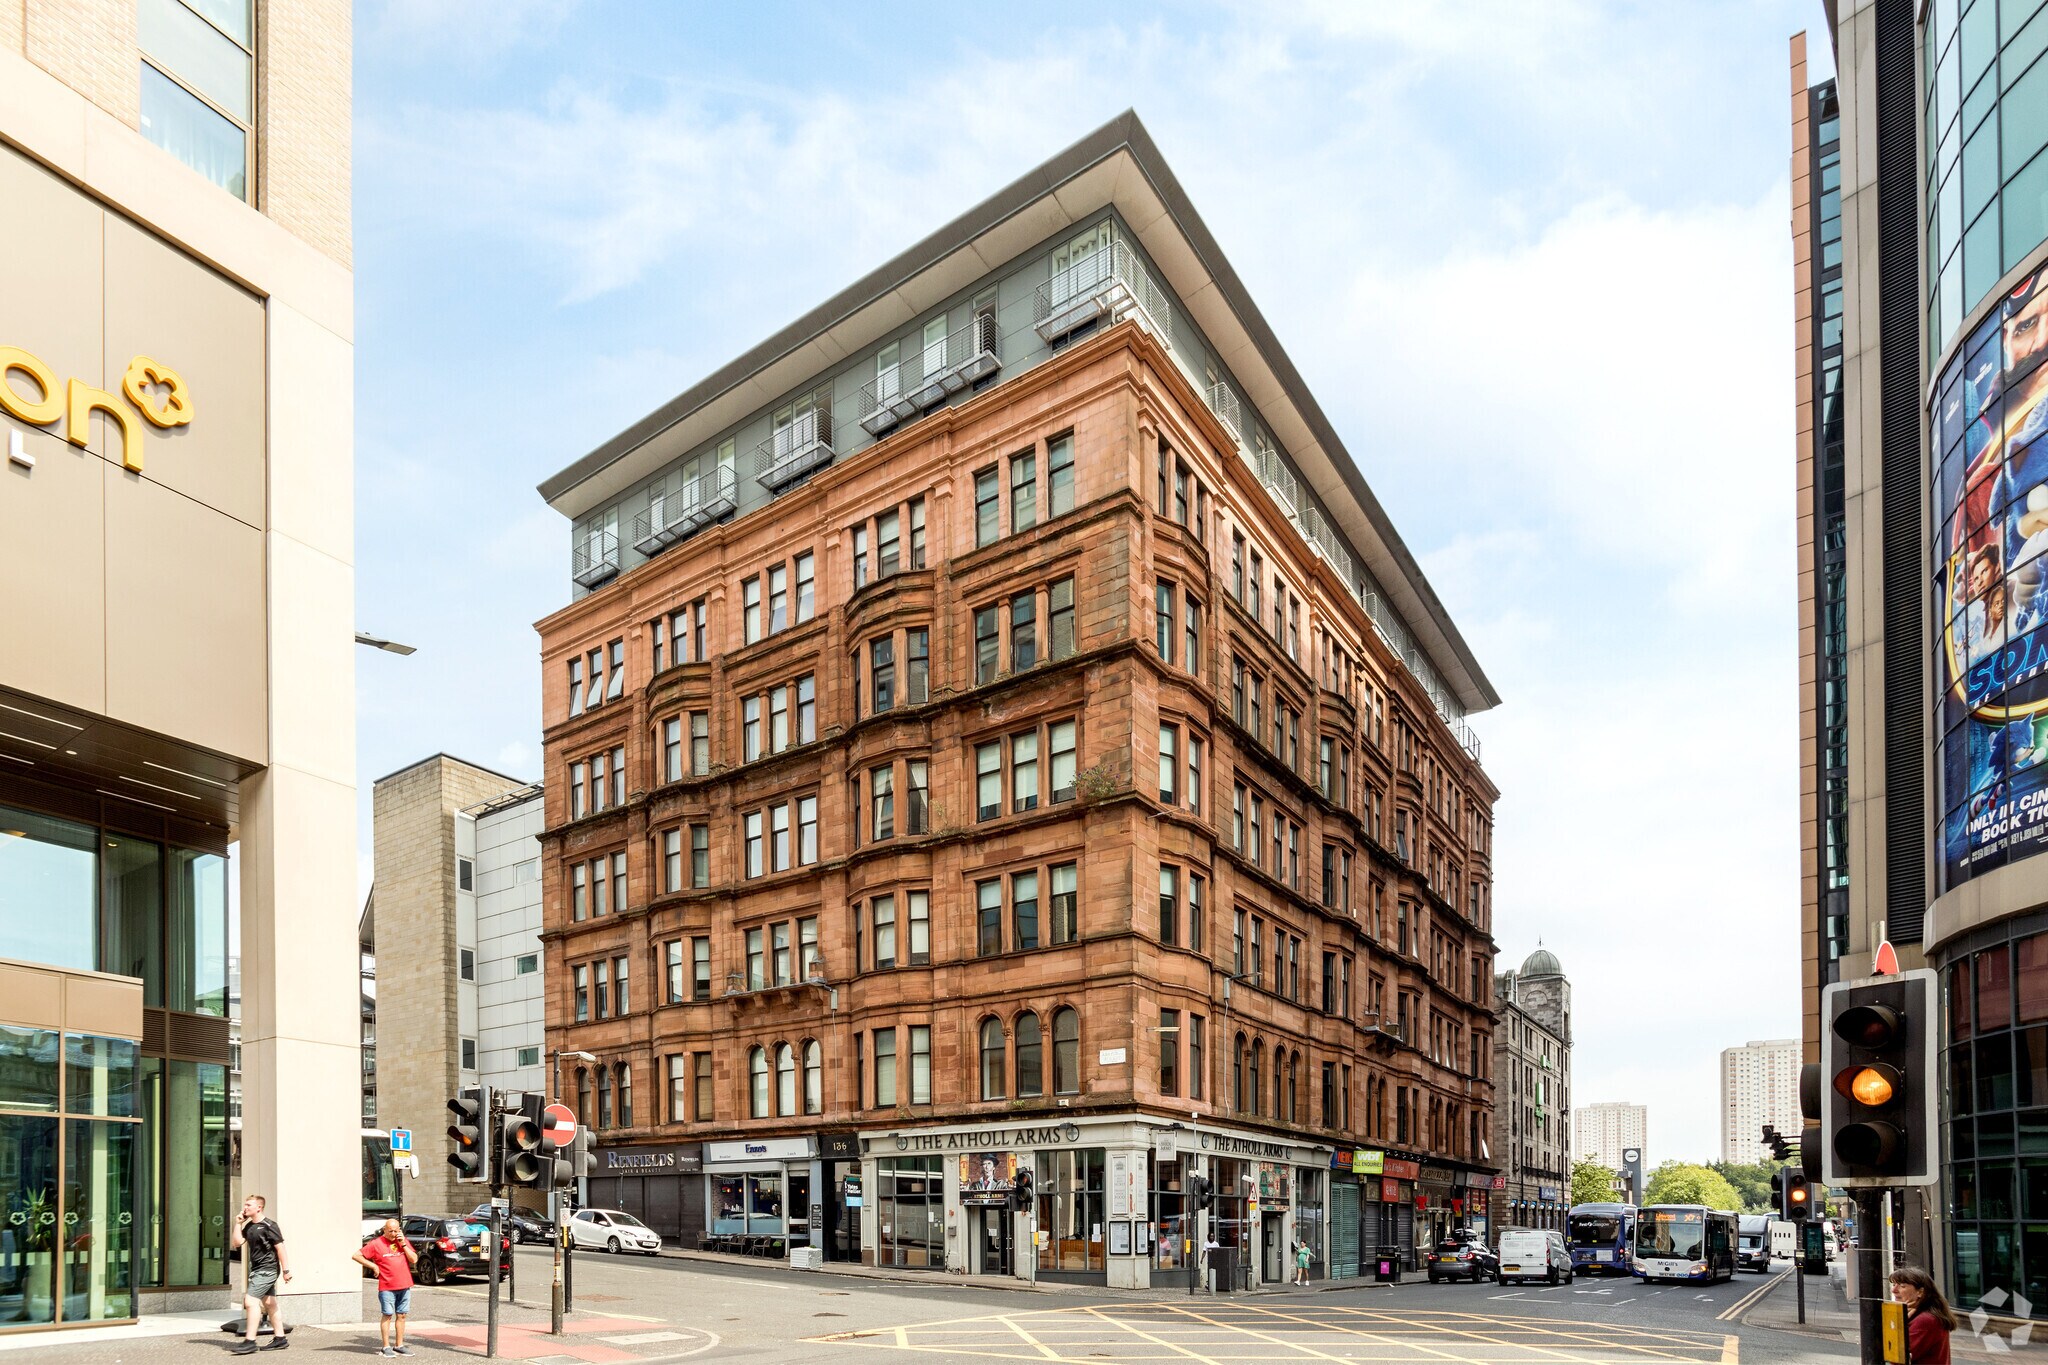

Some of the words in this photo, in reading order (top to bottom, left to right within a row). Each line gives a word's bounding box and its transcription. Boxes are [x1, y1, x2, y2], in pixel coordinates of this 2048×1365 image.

[1965, 809, 1997, 836] ONLY
[1981, 813, 2023, 843] BOOK
[833, 1142, 847, 1151] 136
[912, 1135, 942, 1150] THE
[947, 1130, 1010, 1148] ATHOLL
[1015, 1127, 1061, 1145] ARMS
[1213, 1135, 1231, 1151] THE
[1231, 1138, 1263, 1156] ATHOLL
[1263, 1142, 1283, 1158] ARMS
[1357, 1151, 1381, 1161] wbf
